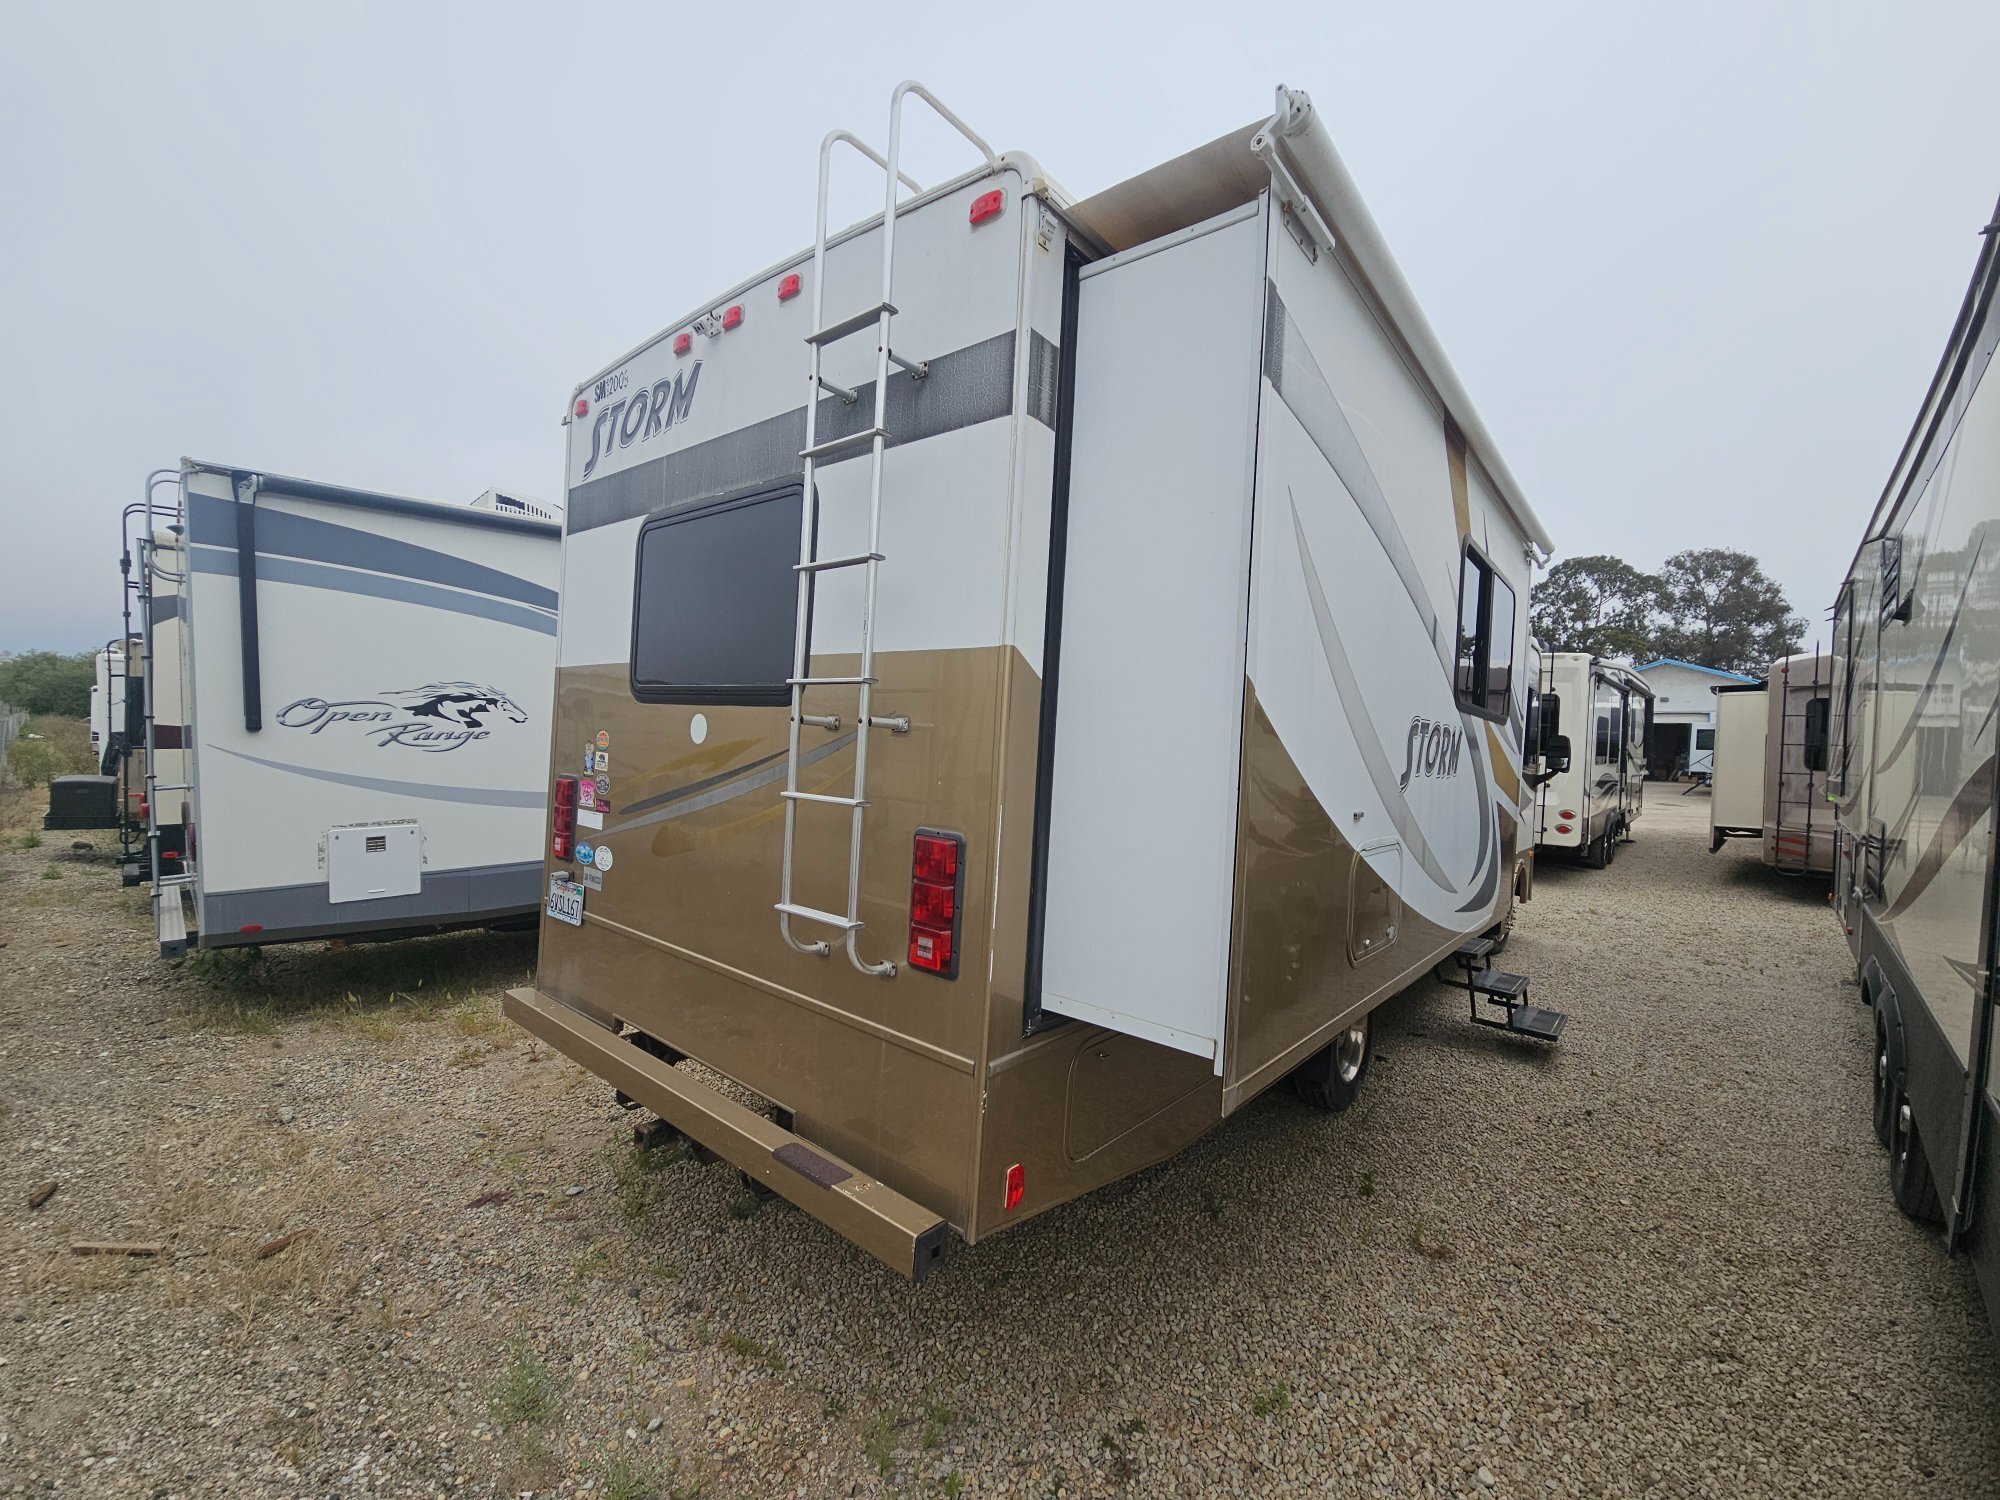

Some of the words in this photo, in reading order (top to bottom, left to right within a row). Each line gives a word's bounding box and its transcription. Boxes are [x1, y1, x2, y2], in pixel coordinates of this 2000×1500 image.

[582, 360, 703, 482] STORM
[276, 697, 398, 734] Open
[364, 721, 491, 753] Range
[1399, 715, 1463, 795] STORM
